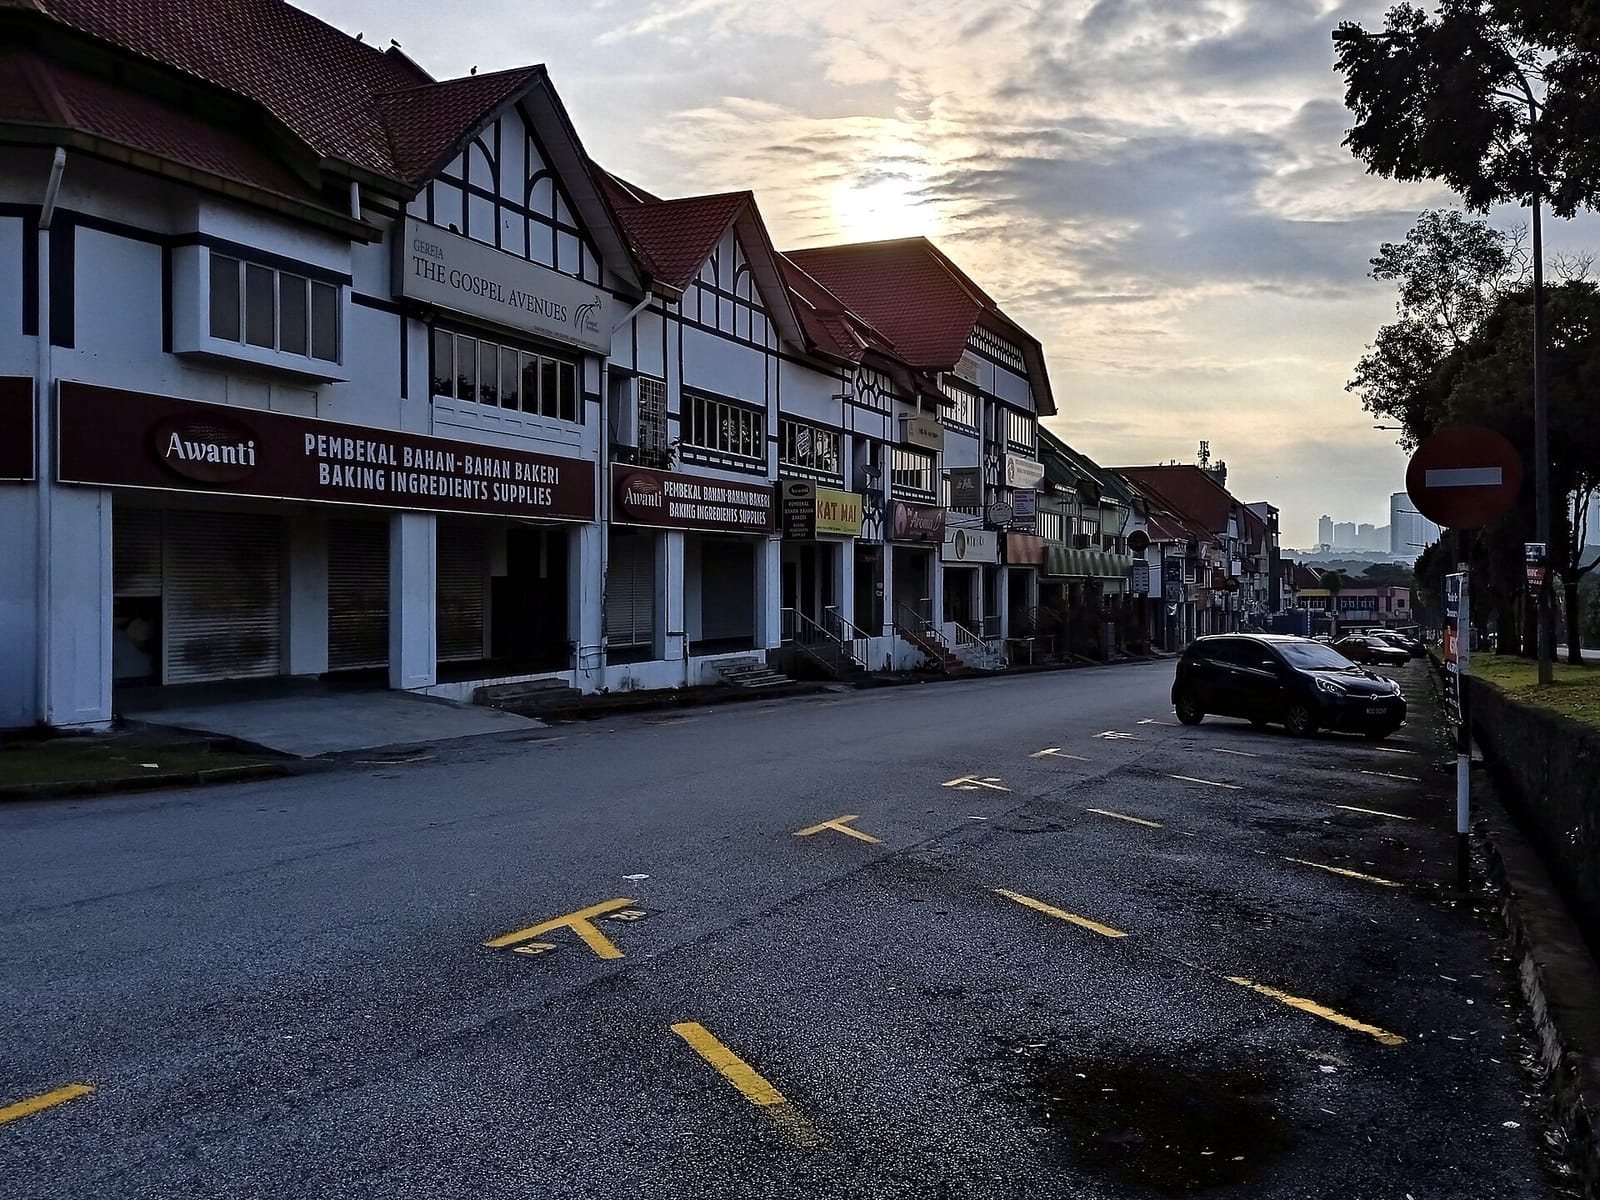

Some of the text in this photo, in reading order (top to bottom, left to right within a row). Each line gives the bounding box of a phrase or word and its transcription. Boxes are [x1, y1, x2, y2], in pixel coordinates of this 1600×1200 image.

[414, 240, 443, 259] GEREJA
[413, 256, 567, 322] THE GOSPEL AVENUES
[165, 432, 255, 466] Awanti
[305, 433, 559, 485] PEMBEKAL BAHAN-BAHAN BAKERI
[319, 463, 552, 506] BAKING INGREDIENTS SUPPLIES
[664, 480, 702, 500] PEMBEKAL
[624, 487, 662, 508] Awanti
[669, 502, 766, 525] BAKING INGREDIENTS SUPPLIES
[817, 500, 857, 522] KAT MAI
